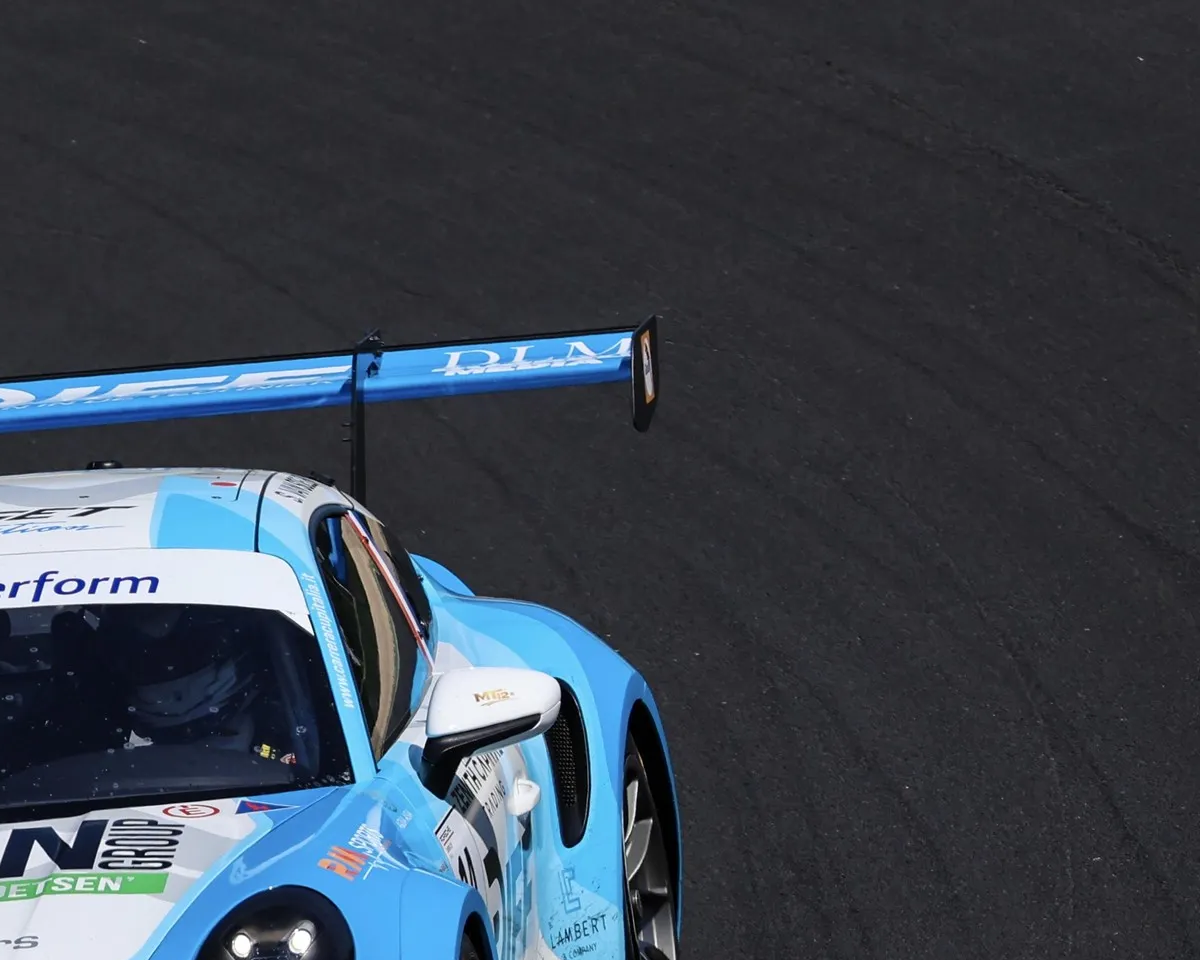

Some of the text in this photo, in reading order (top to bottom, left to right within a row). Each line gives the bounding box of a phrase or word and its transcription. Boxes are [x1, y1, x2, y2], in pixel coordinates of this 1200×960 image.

[434, 338, 632, 374] DLM
[98, 818, 185, 871] GROUP
[550, 914, 608, 950] LAMBERT
